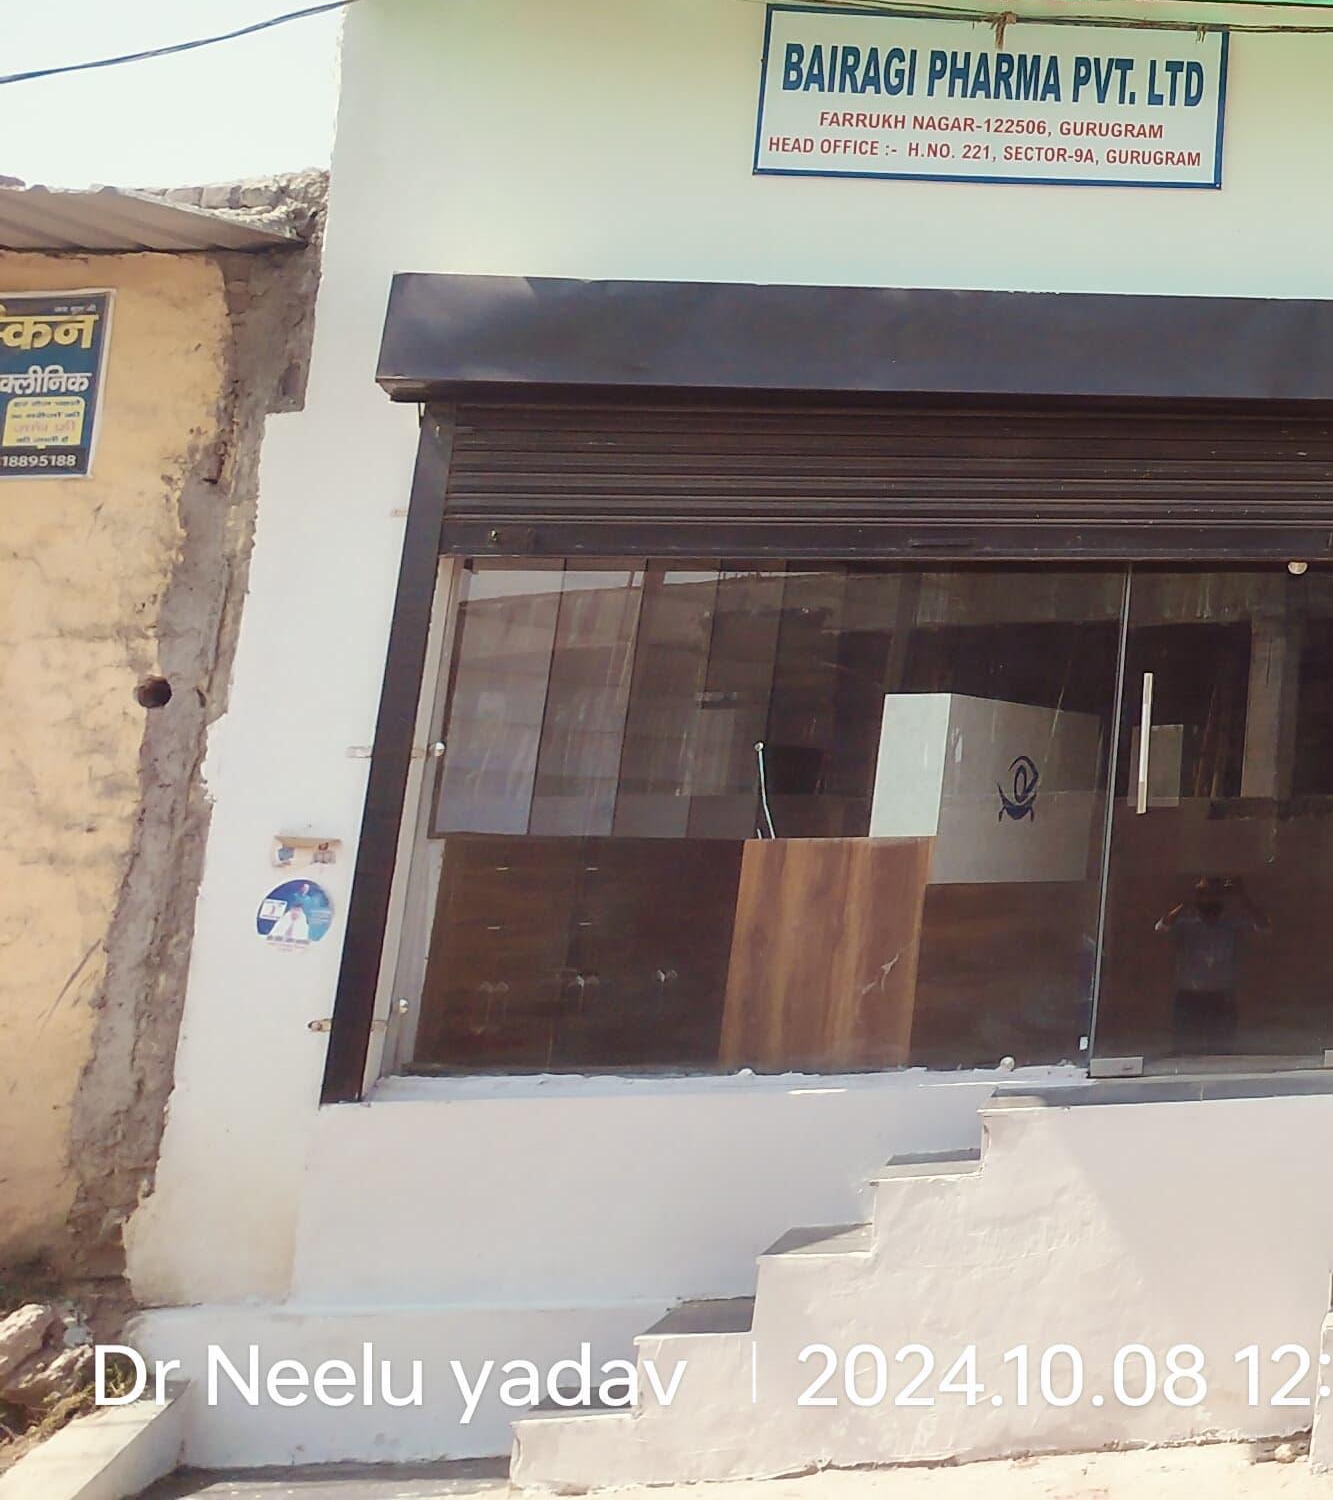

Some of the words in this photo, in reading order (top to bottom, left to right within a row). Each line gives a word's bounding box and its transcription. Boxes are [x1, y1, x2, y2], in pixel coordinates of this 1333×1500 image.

[782, 43, 917, 96] BAIRAGI
[927, 51, 1061, 102] PHARMA
[1072, 56, 1136, 105] PVT.
[1147, 59, 1204, 107] LTD
[819, 111, 906, 130] FARRUKH
[913, 115, 1052, 137] NAGAR-122506,
[1060, 120, 1164, 140] GURUGRAM
[769, 137, 814, 153] HEAD
[820, 139, 879, 156] OFFICE
[908, 141, 956, 158] H.NO.
[962, 144, 996, 161] 221,
[1002, 145, 1099, 165] SECTOR-9A,
[1106, 149, 1201, 167] GURUGRAM
